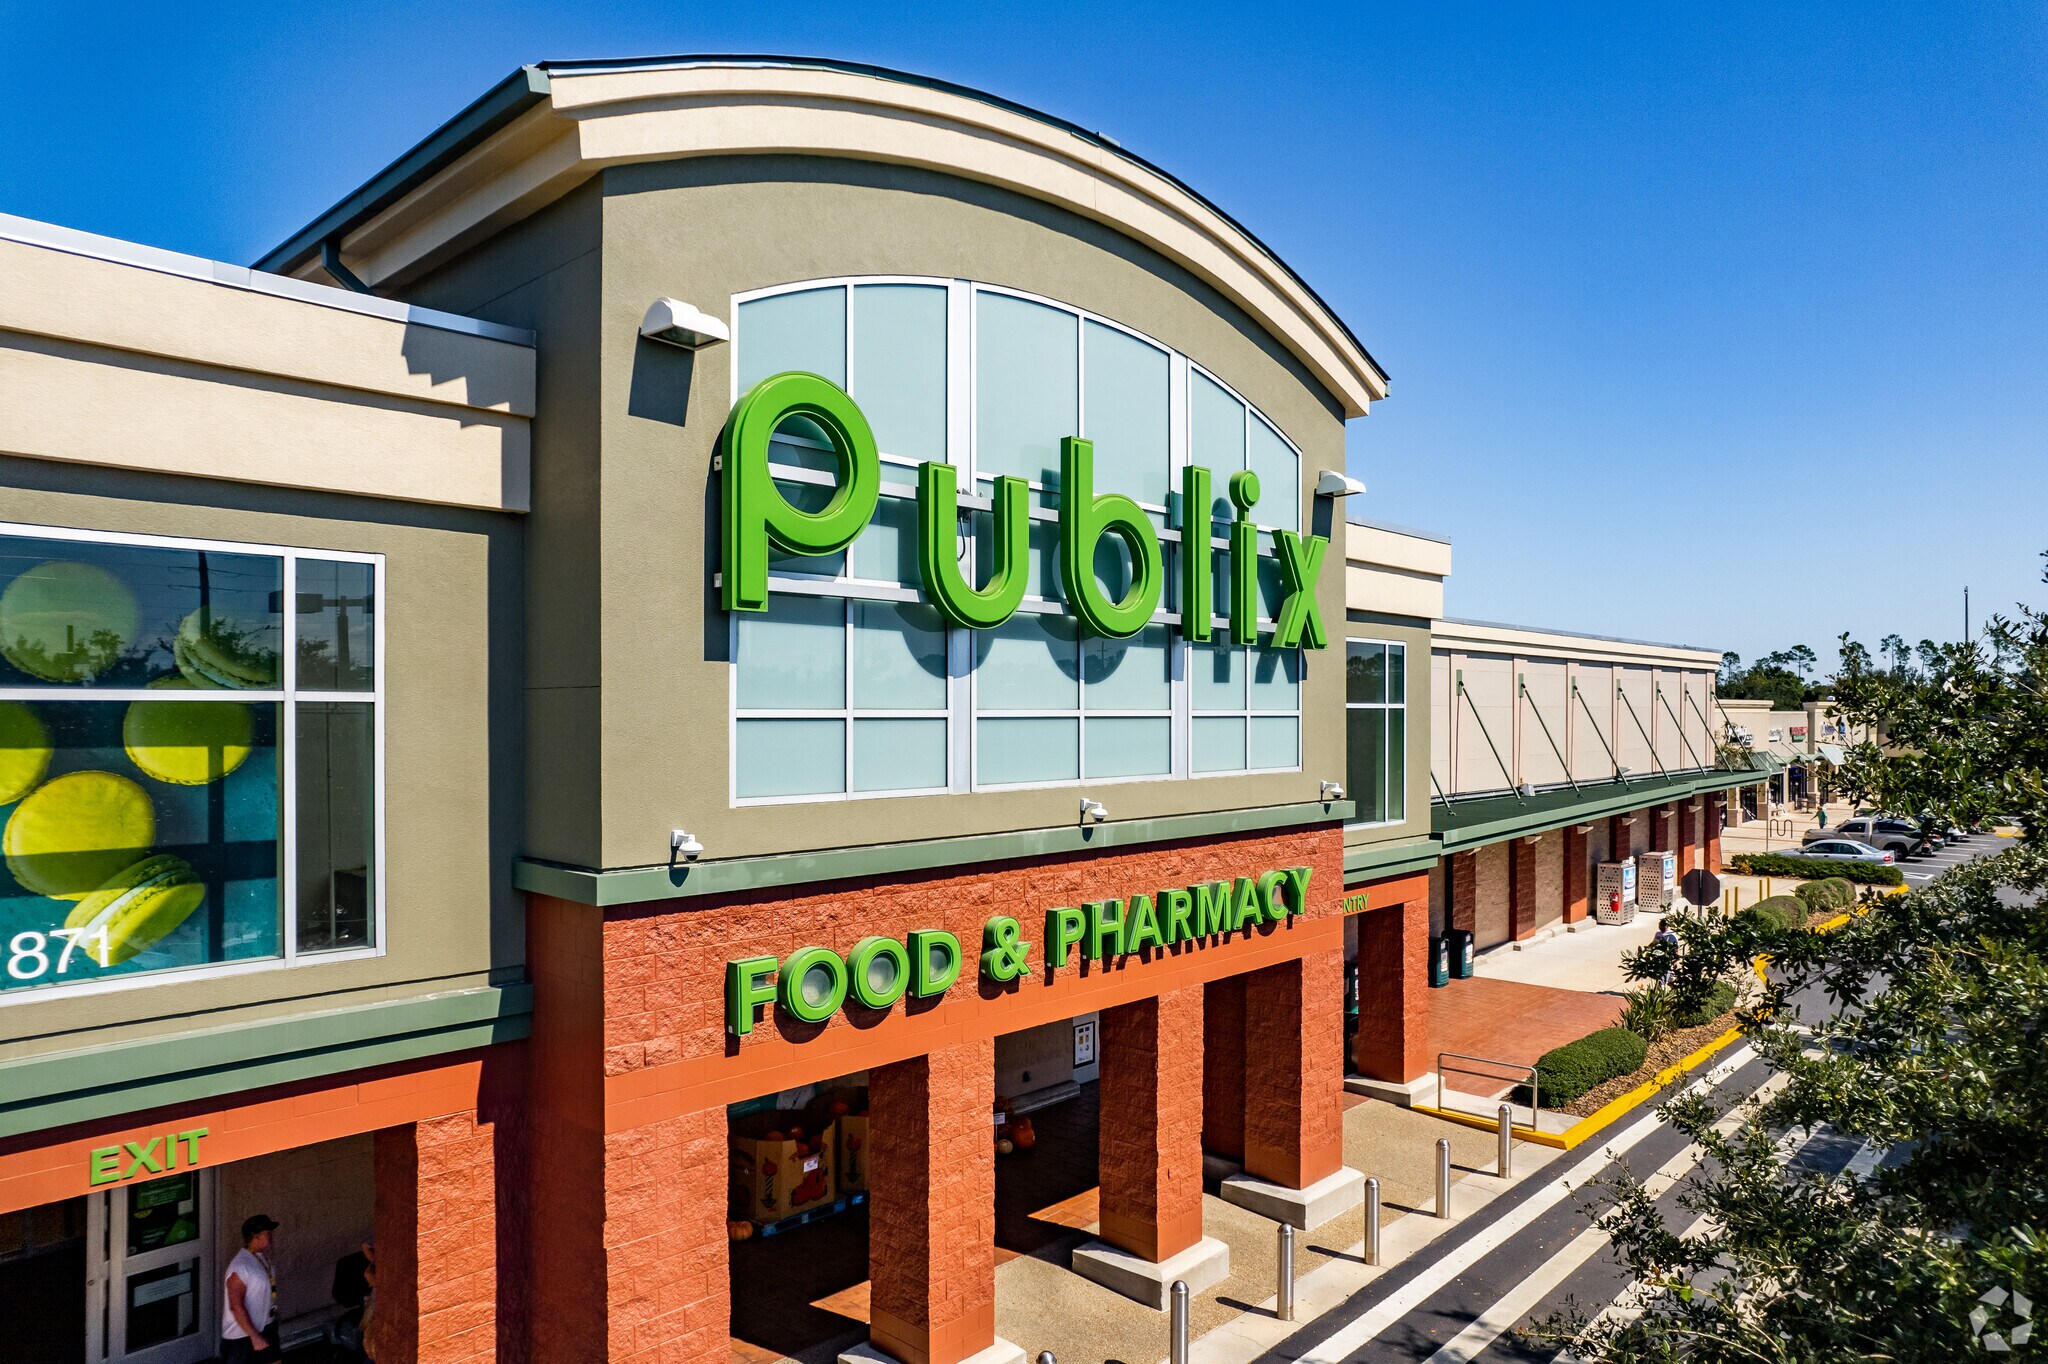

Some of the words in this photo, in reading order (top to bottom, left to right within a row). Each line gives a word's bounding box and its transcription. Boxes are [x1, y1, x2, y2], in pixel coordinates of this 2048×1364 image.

[721, 370, 1329, 650] Publix
[1342, 893, 1370, 914] NTRY
[0, 924, 110, 980] 871
[727, 929, 962, 1036] FOOD
[980, 916, 1032, 982] &
[1046, 866, 1313, 969] PHARMACY
[90, 1127, 209, 1187] EXIT
